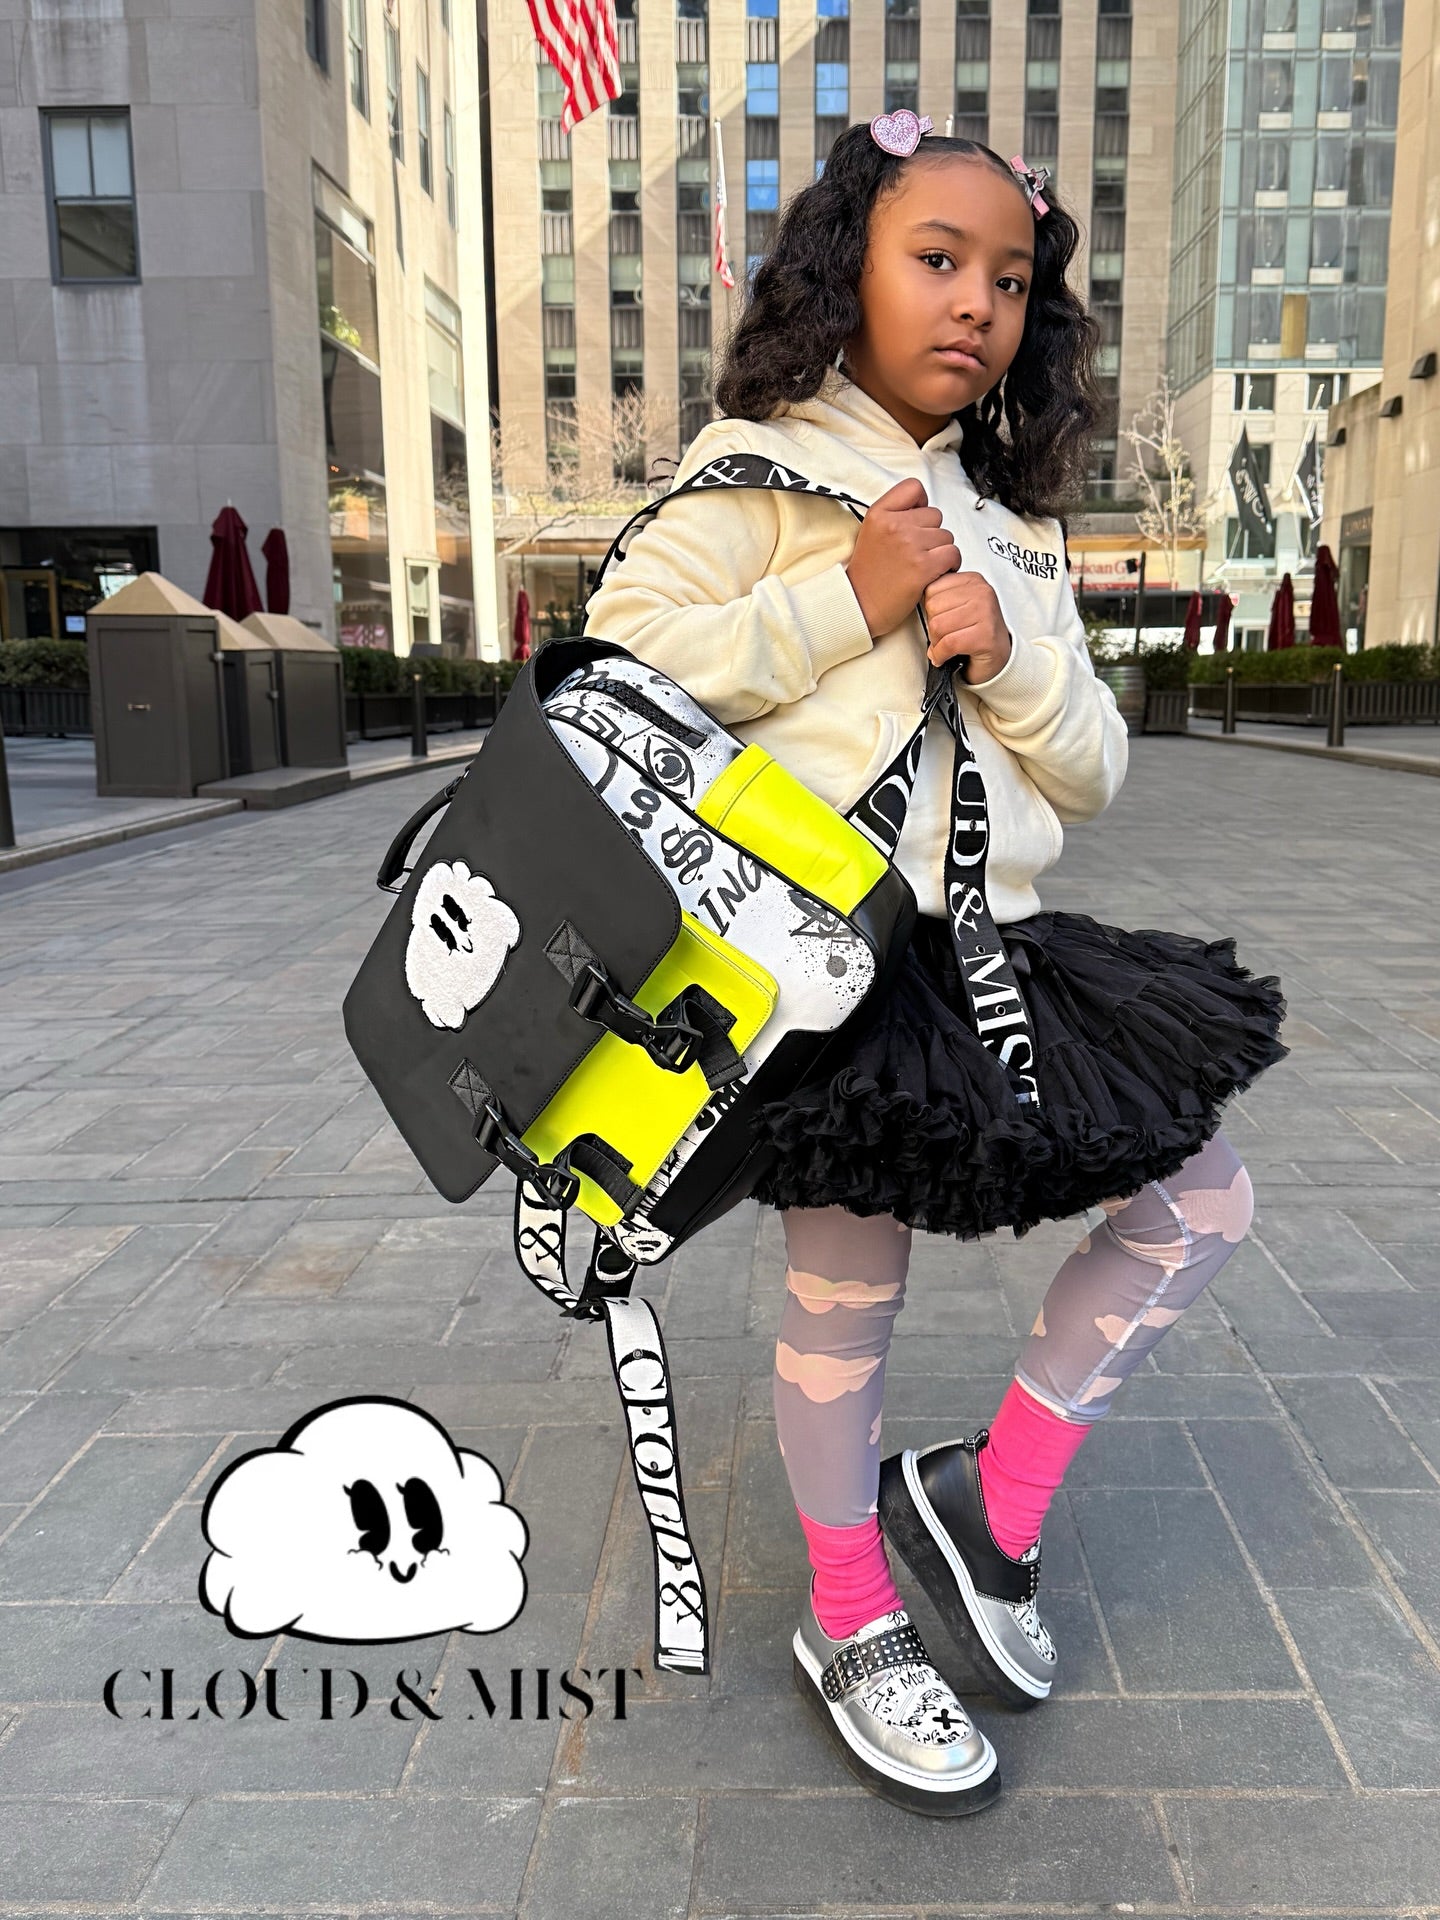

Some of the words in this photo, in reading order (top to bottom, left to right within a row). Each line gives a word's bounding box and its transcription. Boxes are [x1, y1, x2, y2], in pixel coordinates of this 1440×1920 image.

[692, 458, 748, 488] &
[1007, 541, 1058, 567] CLOUD
[1012, 555, 1023, 570] &
[1023, 559, 1058, 580] MIST
[949, 881, 986, 942] &
